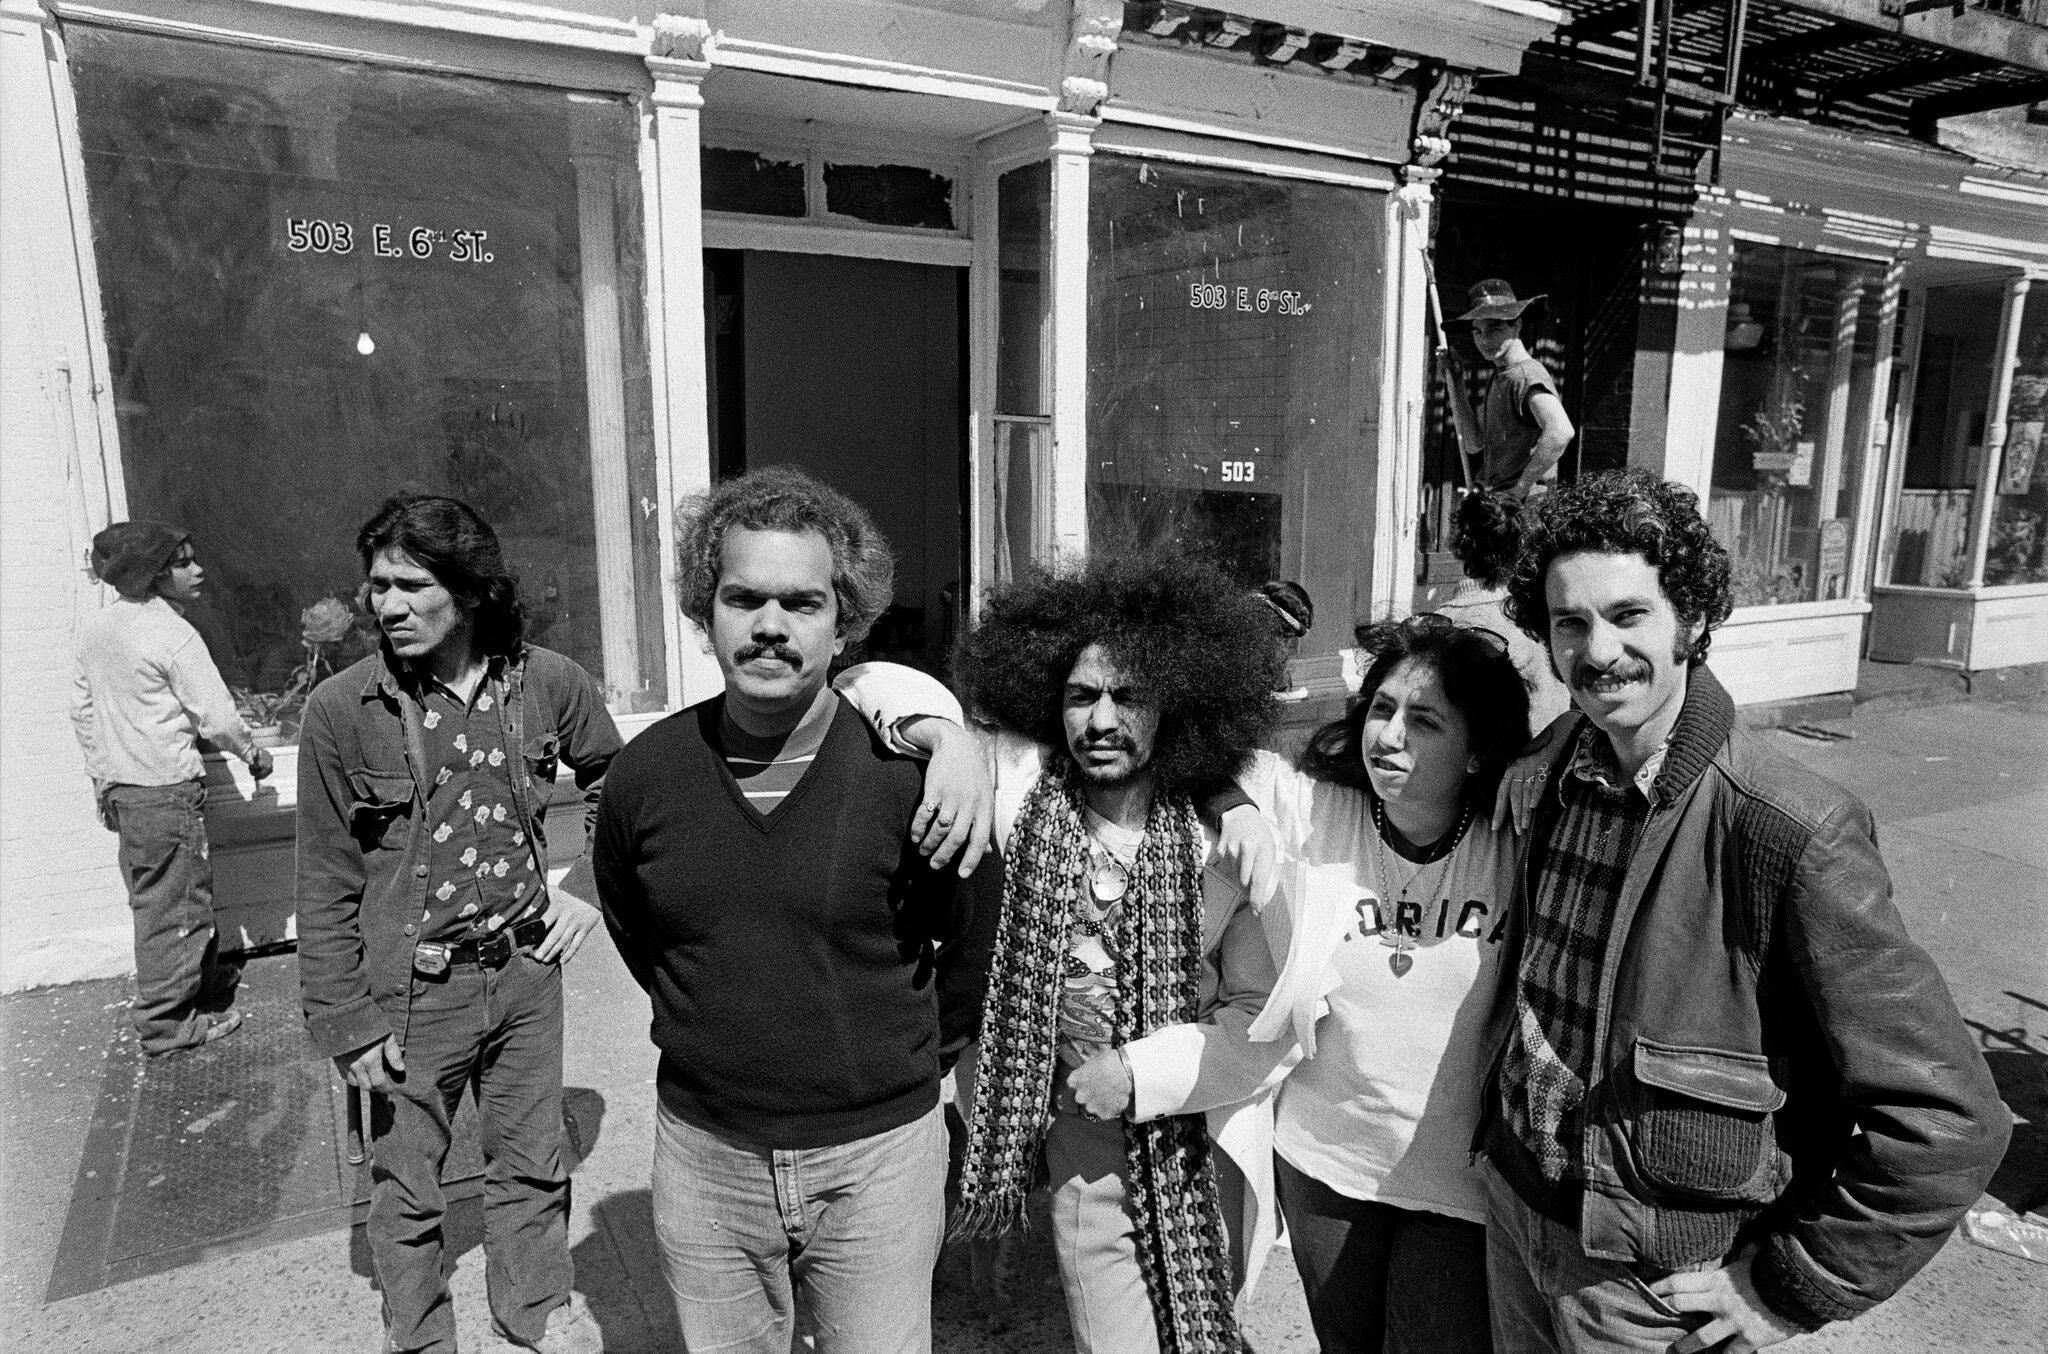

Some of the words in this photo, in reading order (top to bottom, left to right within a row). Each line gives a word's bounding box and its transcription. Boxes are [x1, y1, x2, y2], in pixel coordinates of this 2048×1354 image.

[287, 218, 353, 254] 503
[372, 223, 402, 257] E.
[449, 228, 494, 262] ST.
[1190, 283, 1226, 309] 503
[1236, 286, 1253, 312] E.
[1278, 290, 1304, 316] ST.
[1221, 461, 1255, 482] 503
[1343, 897, 1509, 945] ORICA
